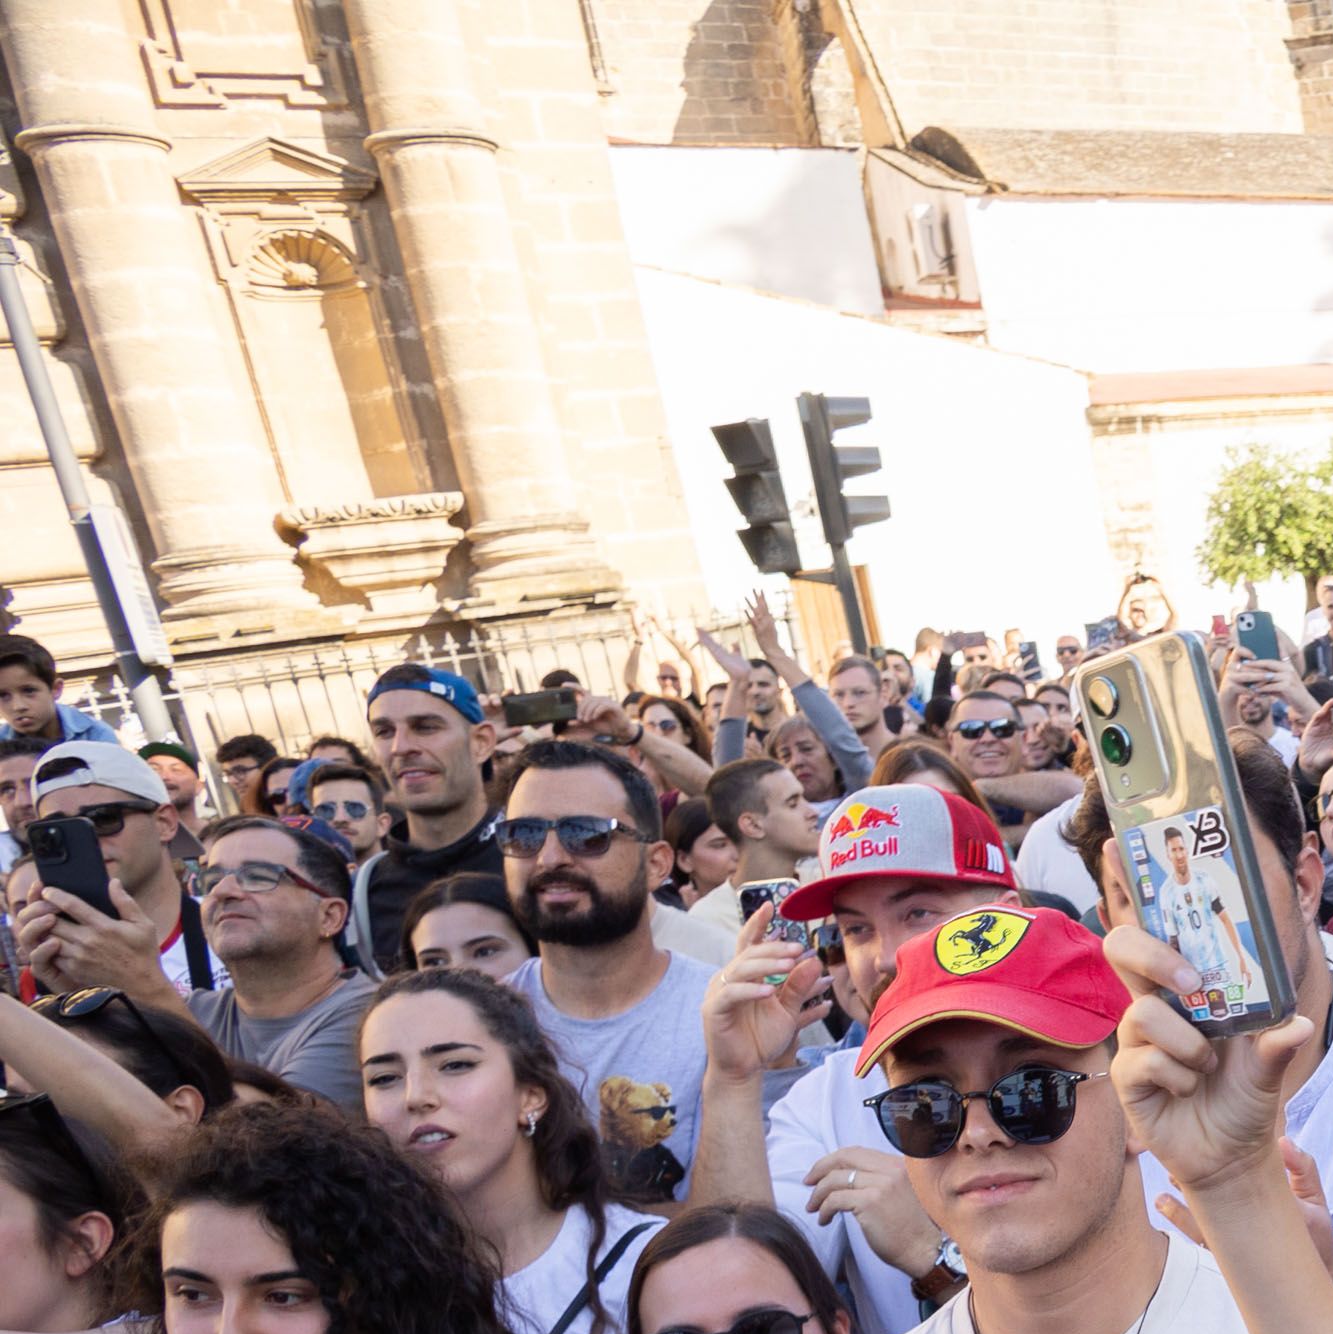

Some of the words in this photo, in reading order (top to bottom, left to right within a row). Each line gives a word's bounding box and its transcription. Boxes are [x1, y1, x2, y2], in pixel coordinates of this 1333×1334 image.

[830, 842, 857, 871] Red
[860, 837, 899, 858] Bull
[1187, 910, 1202, 931] 10
